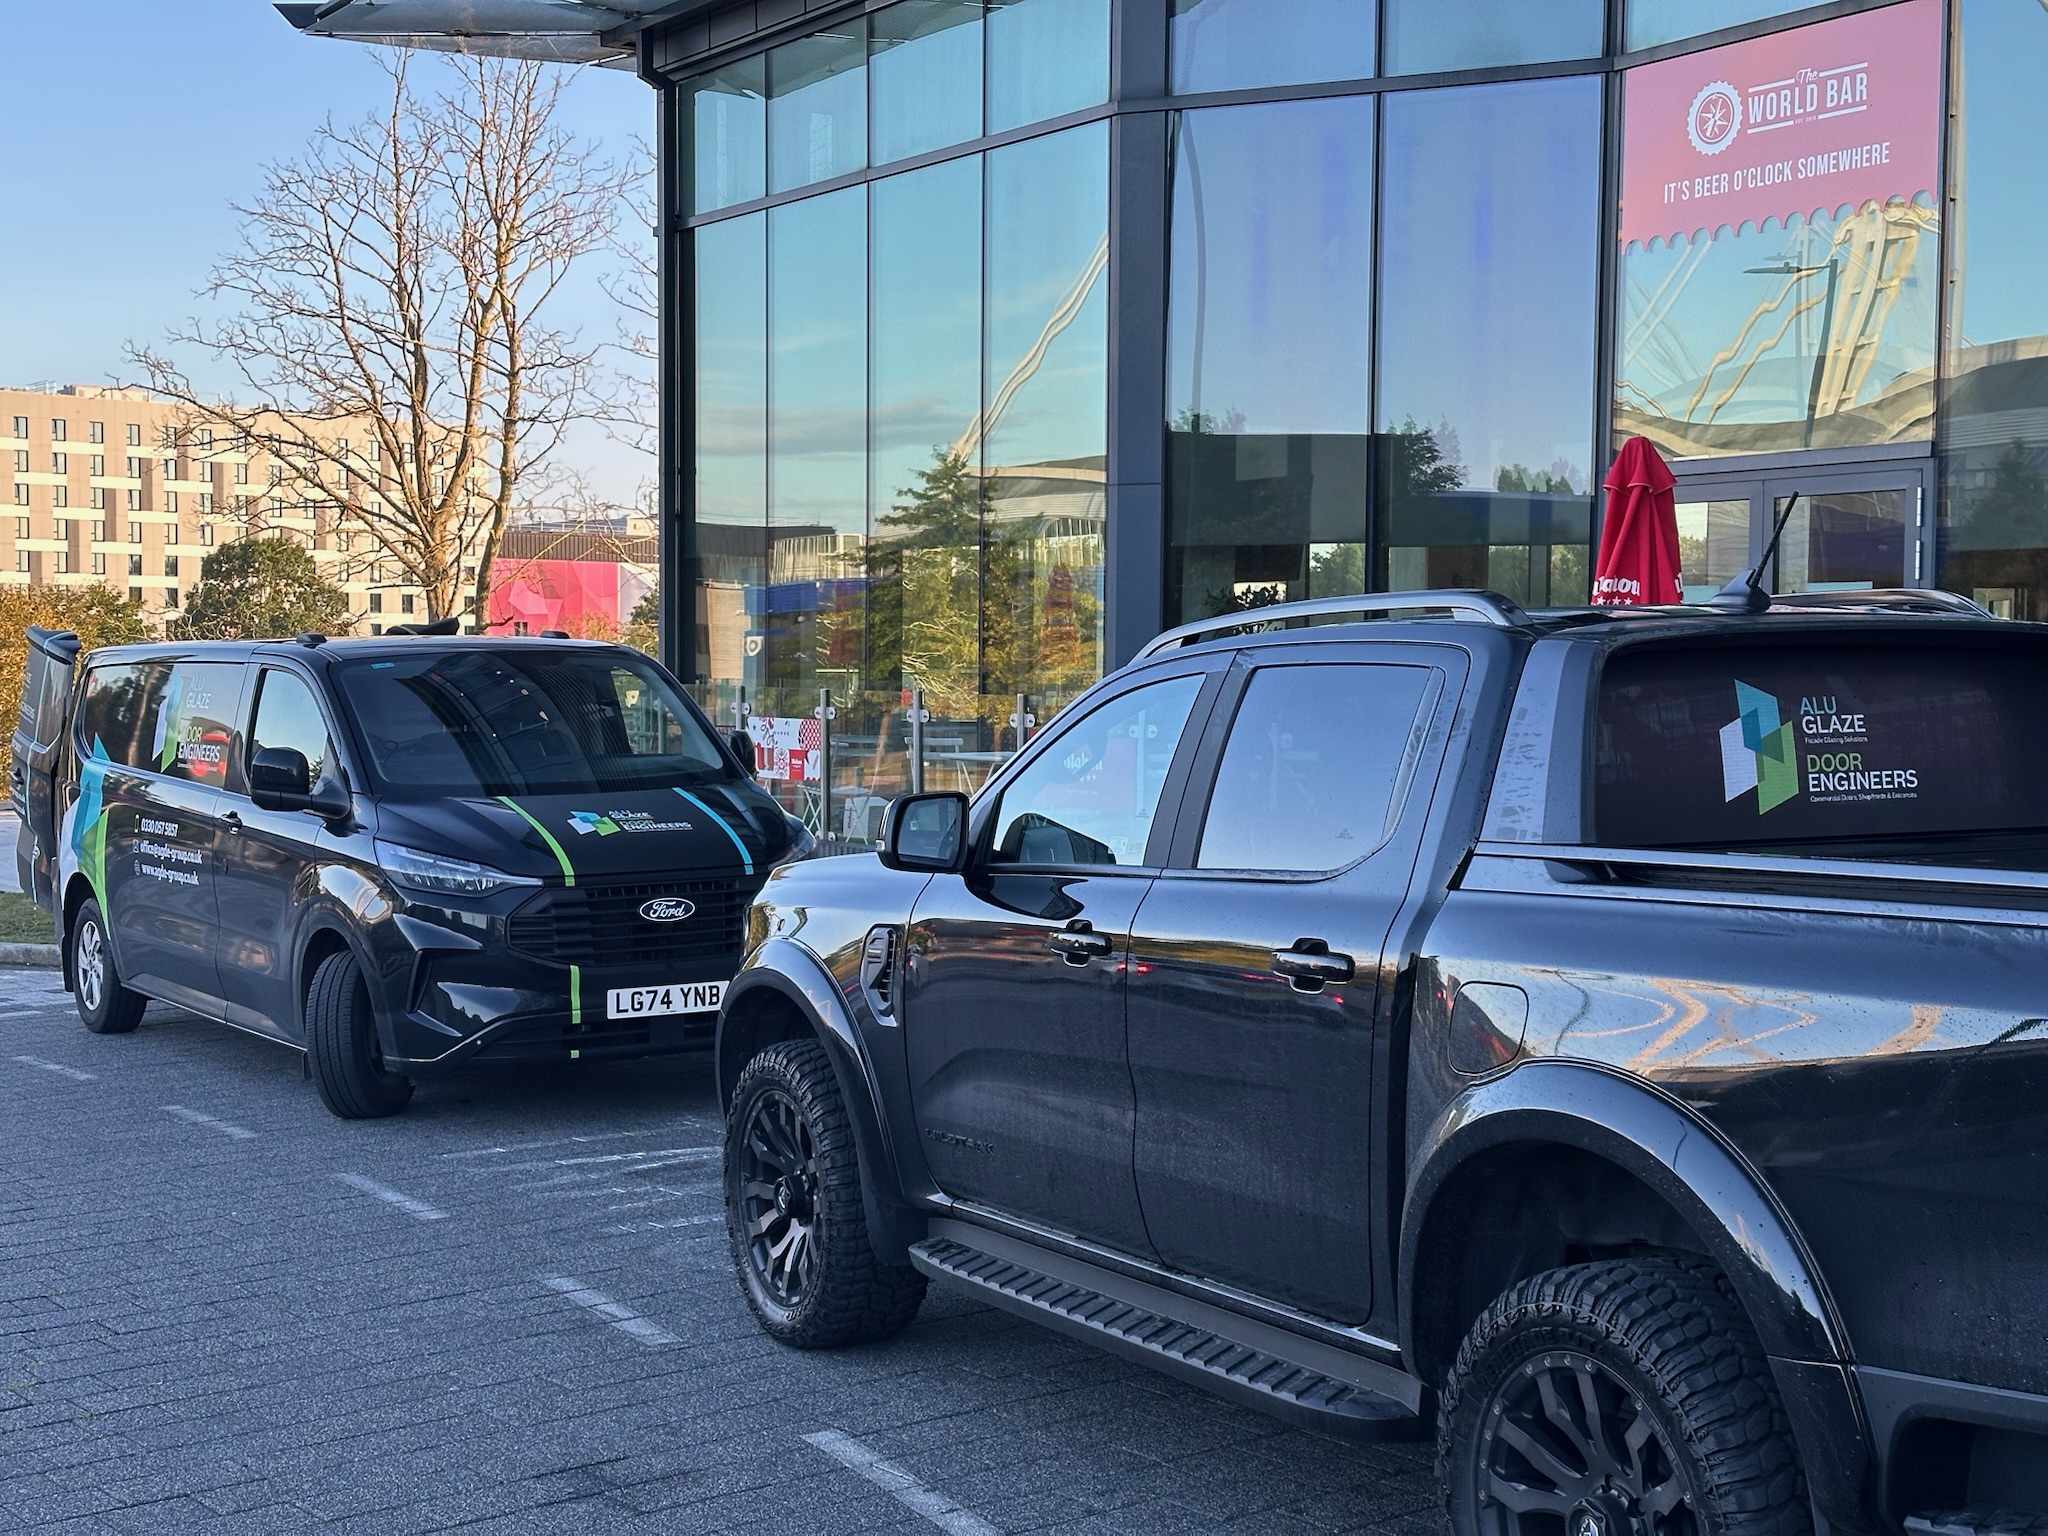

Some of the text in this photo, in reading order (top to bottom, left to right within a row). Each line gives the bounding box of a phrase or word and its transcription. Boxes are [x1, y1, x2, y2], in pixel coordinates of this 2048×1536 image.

[1796, 68, 1818, 84] The
[1747, 72, 1868, 124] WORLD BAR
[1664, 141, 1891, 204] IT'S BEER O'CLOCK SOMEWHERE
[190, 675, 206, 691] ALU
[186, 692, 211, 709] GLAZE
[1800, 696, 1837, 715] ALU
[1802, 714, 1867, 734] GLAZE
[178, 742, 221, 763] ENGINEERS
[1807, 753, 1862, 772] DOOR
[1808, 770, 1918, 792] ENGINEERS
[141, 817, 155, 833] 0330
[625, 822, 691, 831] ENGINEERS
[649, 900, 686, 918] Ford
[615, 985, 720, 1013] LG74 YNB
